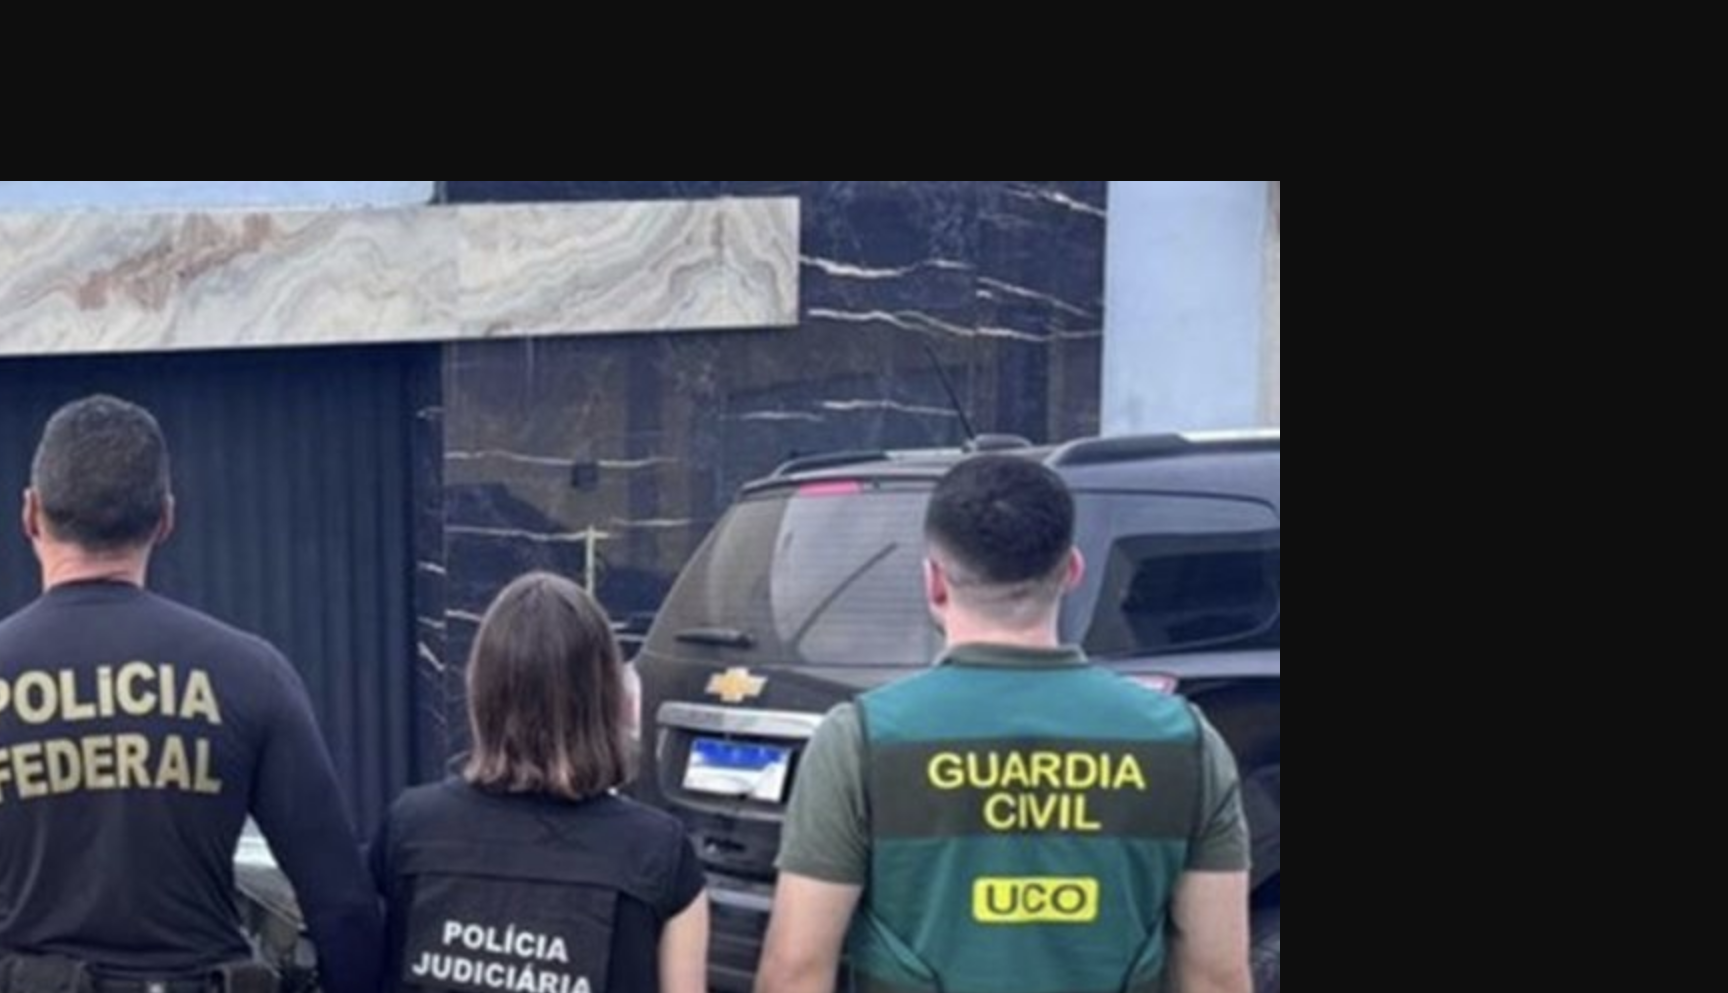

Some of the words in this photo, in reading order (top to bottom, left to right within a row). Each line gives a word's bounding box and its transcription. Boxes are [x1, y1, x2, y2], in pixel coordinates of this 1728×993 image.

[927, 751, 1146, 790] GUARDIA
[983, 793, 1103, 830] CIVIL
[986, 883, 1088, 915] UCO
[442, 919, 569, 963] POLÍCIA
